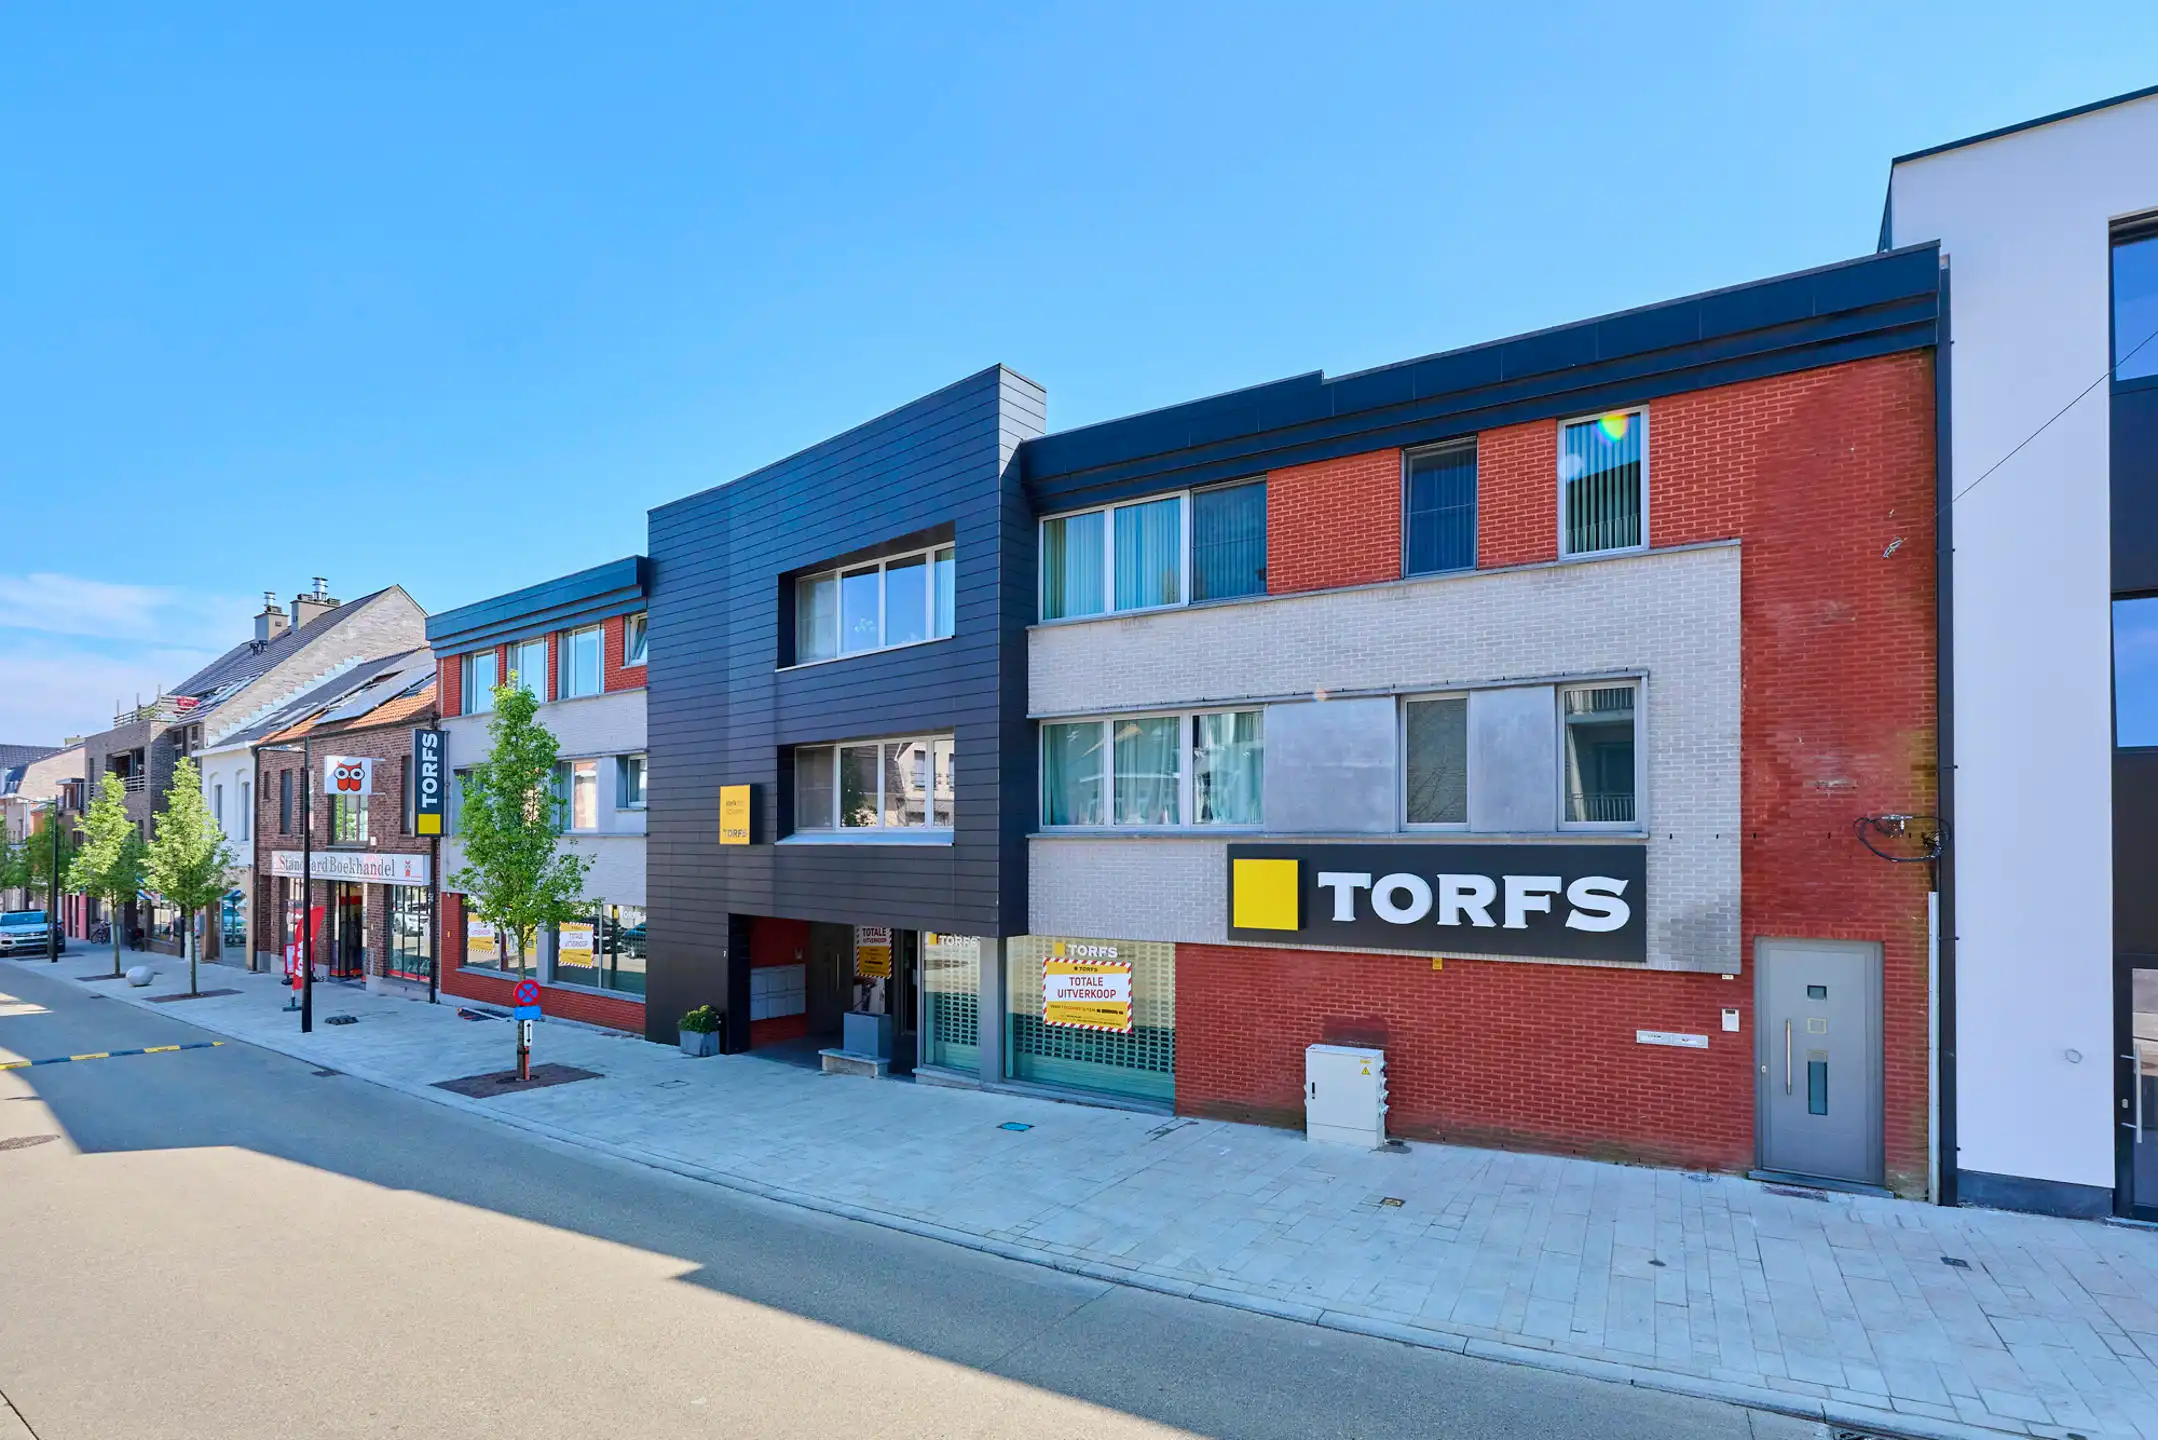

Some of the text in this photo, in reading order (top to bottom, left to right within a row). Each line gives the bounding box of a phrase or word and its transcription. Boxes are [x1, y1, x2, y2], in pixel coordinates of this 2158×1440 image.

[421, 733, 438, 808] TORFS
[279, 855, 396, 877] Stanard Boekhandel
[1317, 871, 1632, 933] TORFS
[862, 927, 887, 937] TOTALE
[940, 935, 979, 948] TORFS
[1068, 944, 1118, 958] TORFS
[1069, 976, 1104, 987] TOTALE
[1057, 988, 1117, 999] UITVERKOOP
